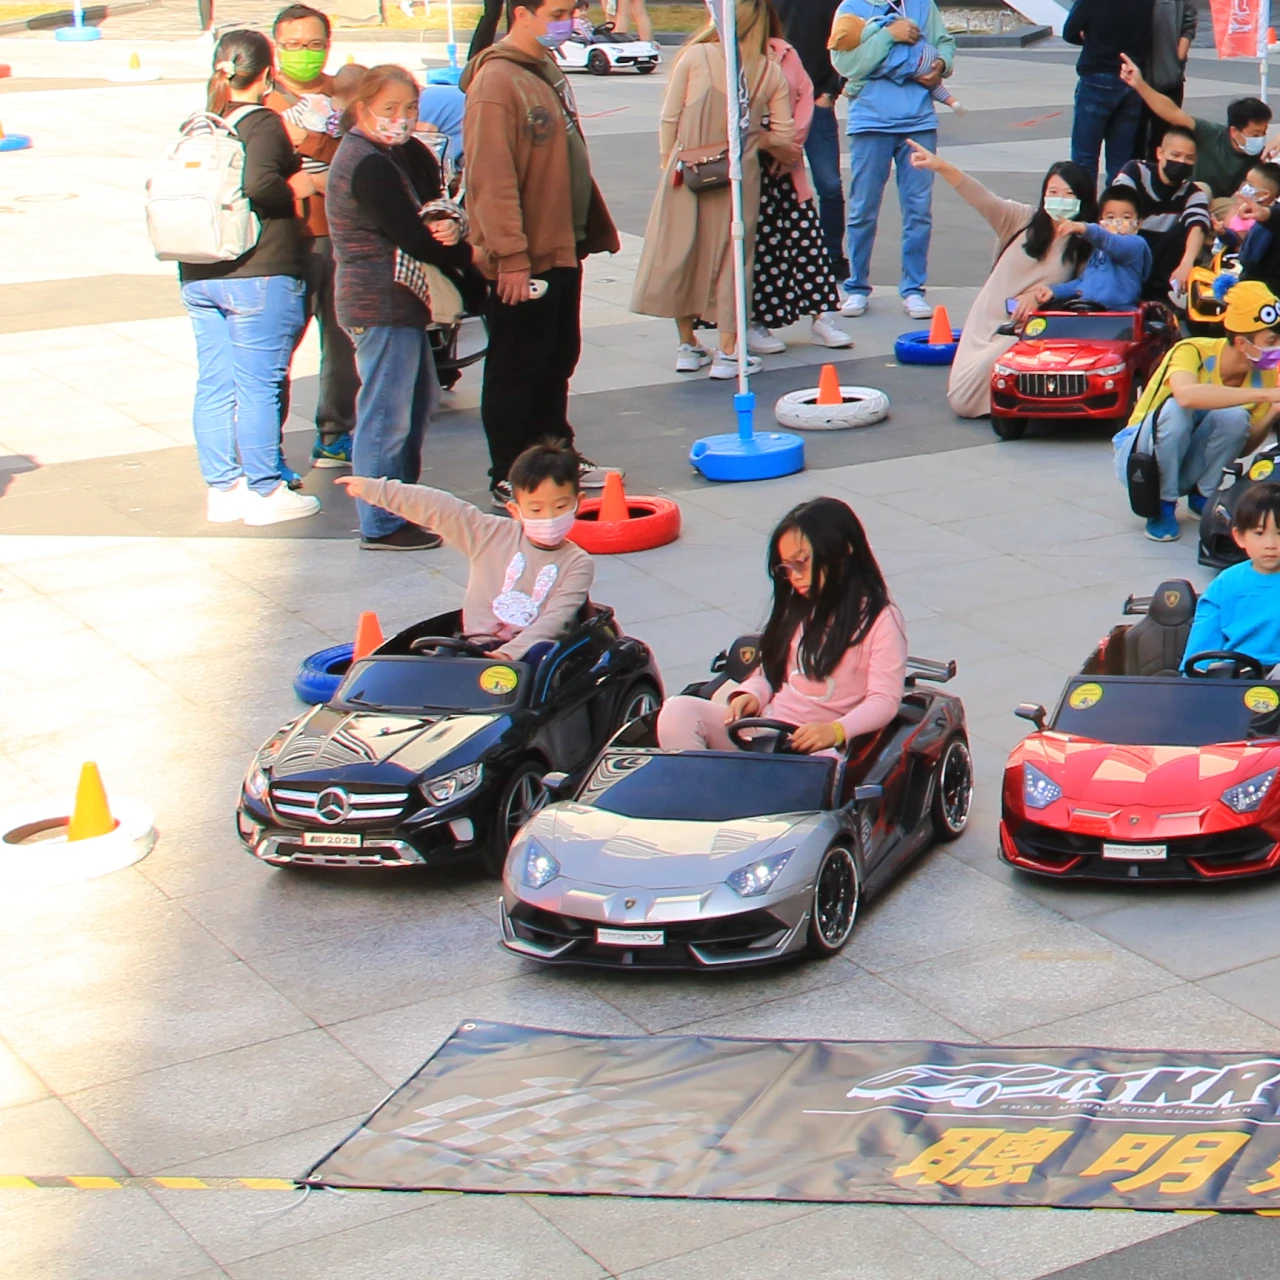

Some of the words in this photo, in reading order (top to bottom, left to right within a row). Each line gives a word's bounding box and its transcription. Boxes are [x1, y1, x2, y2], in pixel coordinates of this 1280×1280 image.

[326, 836, 358, 847] 2028
[1000, 1102, 1052, 1111] SMART
[1058, 1103, 1117, 1113] MOMMY
[1122, 1106, 1159, 1114] KIDS
[1165, 1107, 1216, 1115] SUPER
[1221, 1106, 1253, 1115] CAR
